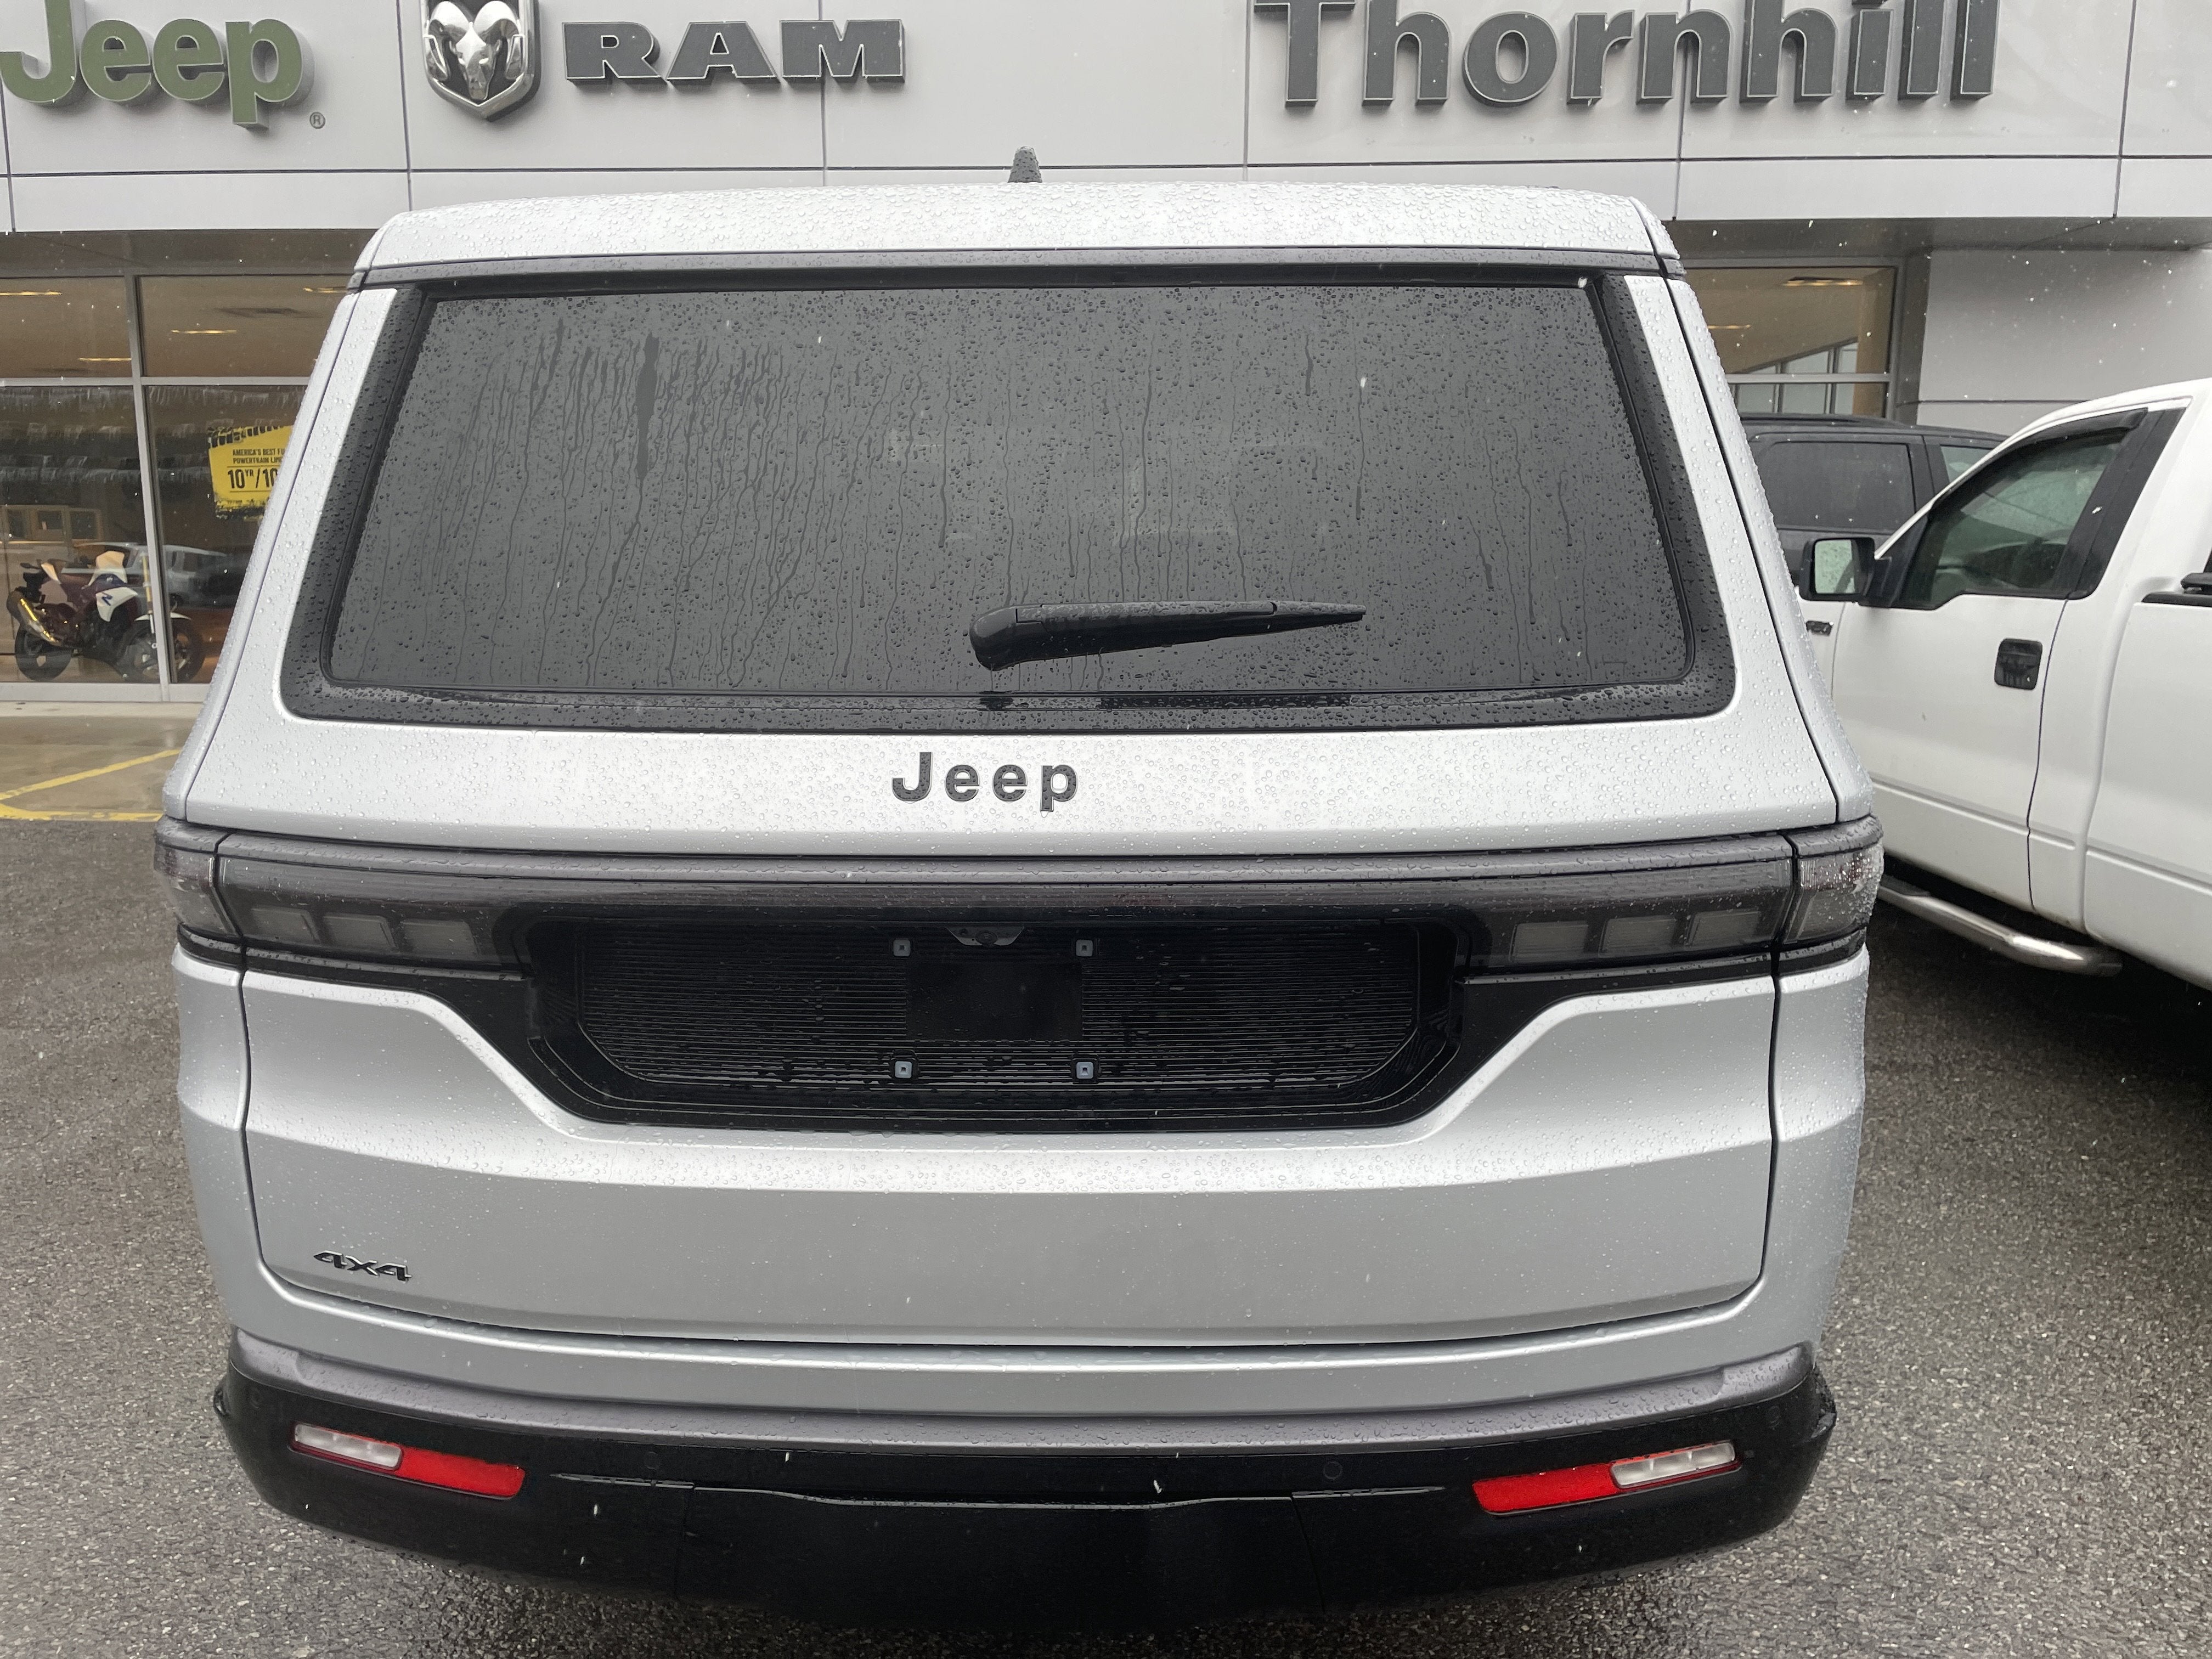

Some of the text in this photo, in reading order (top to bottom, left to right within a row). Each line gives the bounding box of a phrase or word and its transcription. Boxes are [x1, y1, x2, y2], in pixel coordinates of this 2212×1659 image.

[0, 0, 304, 125] Jeep
[562, 19, 904, 80] RAM
[1254, 0, 2000, 103] Thornhill
[891, 752, 1078, 812] Jeep
